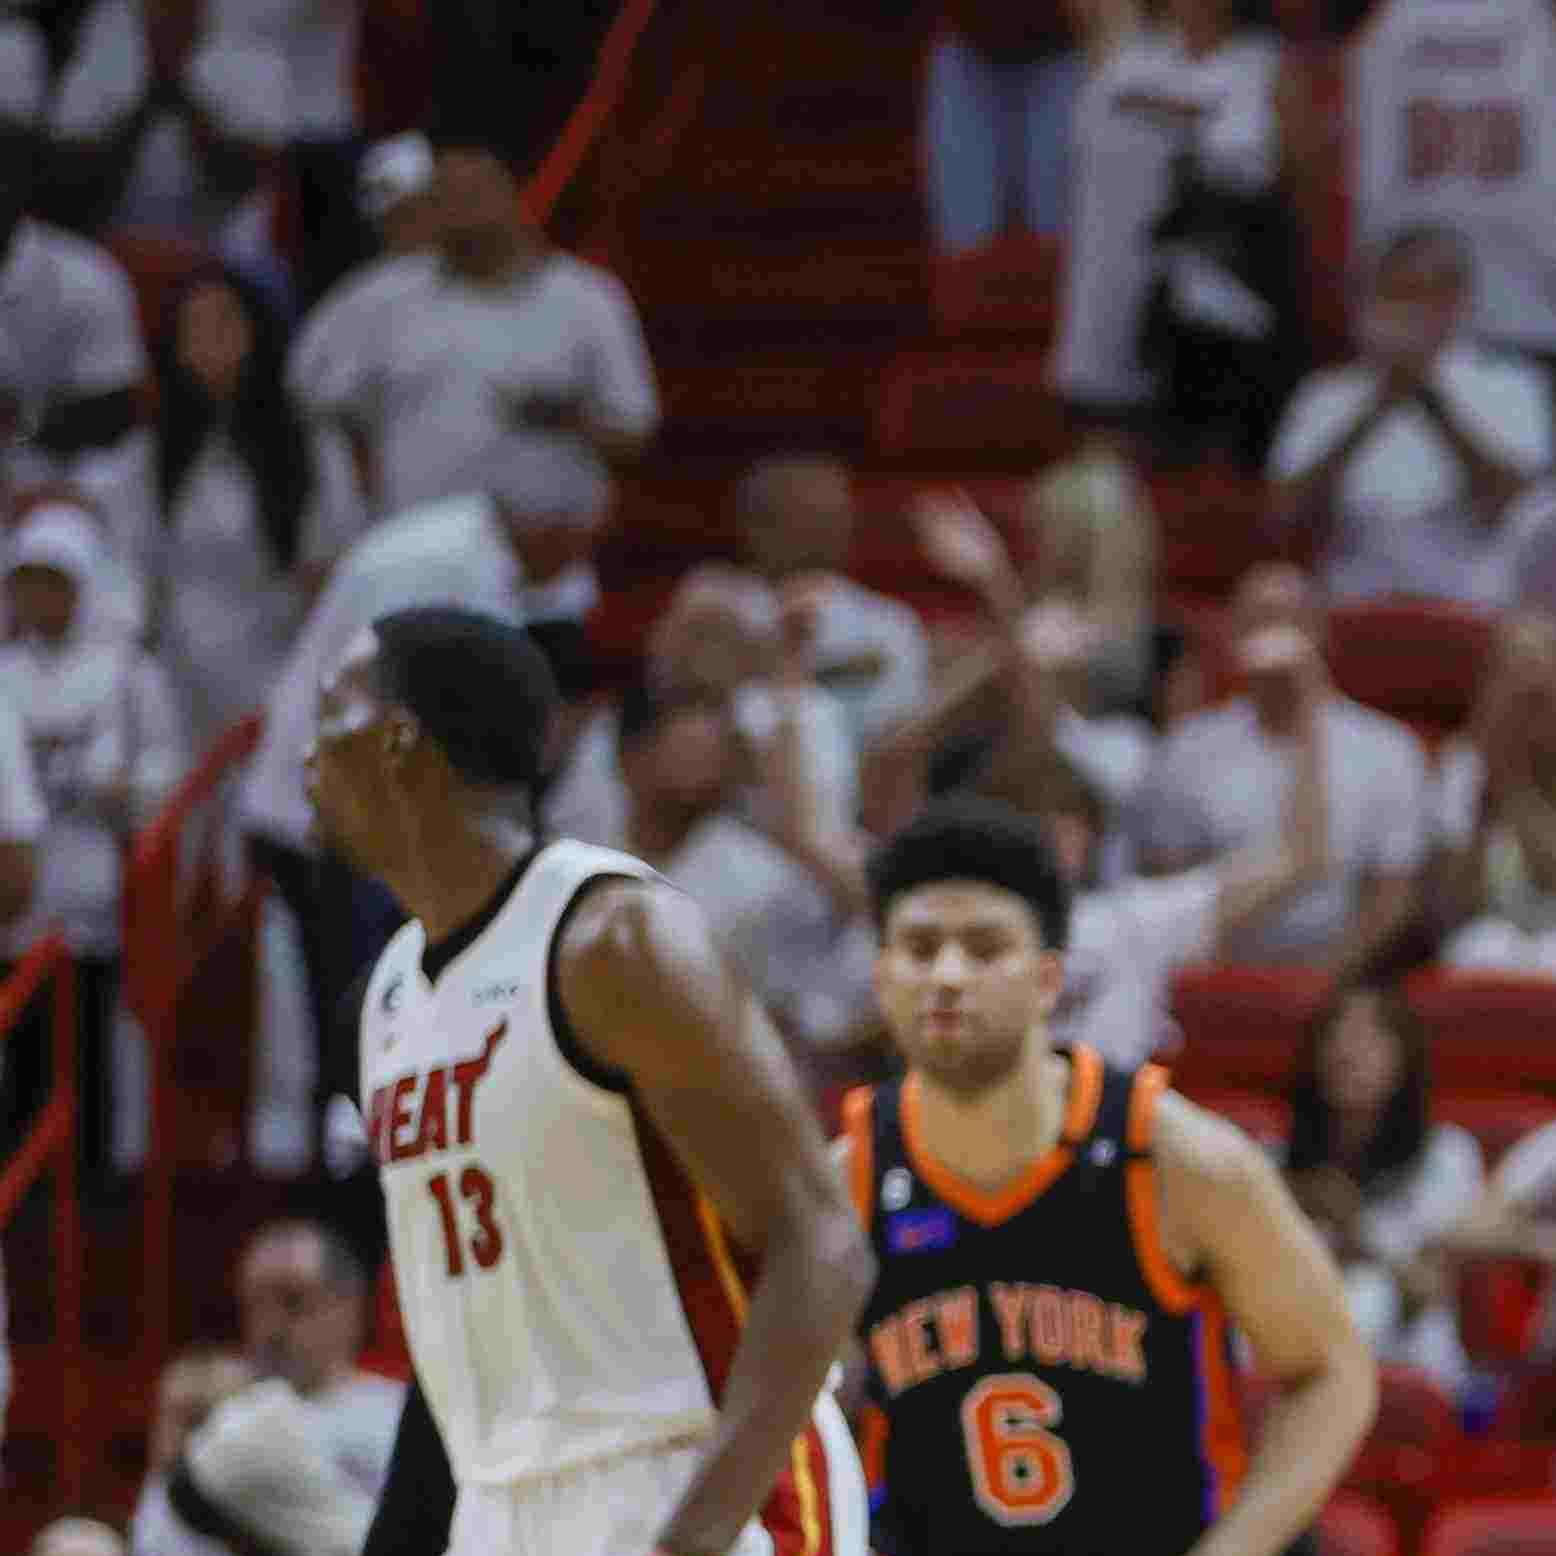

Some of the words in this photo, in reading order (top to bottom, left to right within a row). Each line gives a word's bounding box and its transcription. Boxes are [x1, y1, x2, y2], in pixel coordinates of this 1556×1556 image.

[367, 1014, 509, 1167] HEAT
[429, 1166, 504, 1277] 13
[868, 1283, 979, 1395] NEW
[986, 1279, 1148, 1385] YORK
[960, 1372, 1076, 1530] 6
